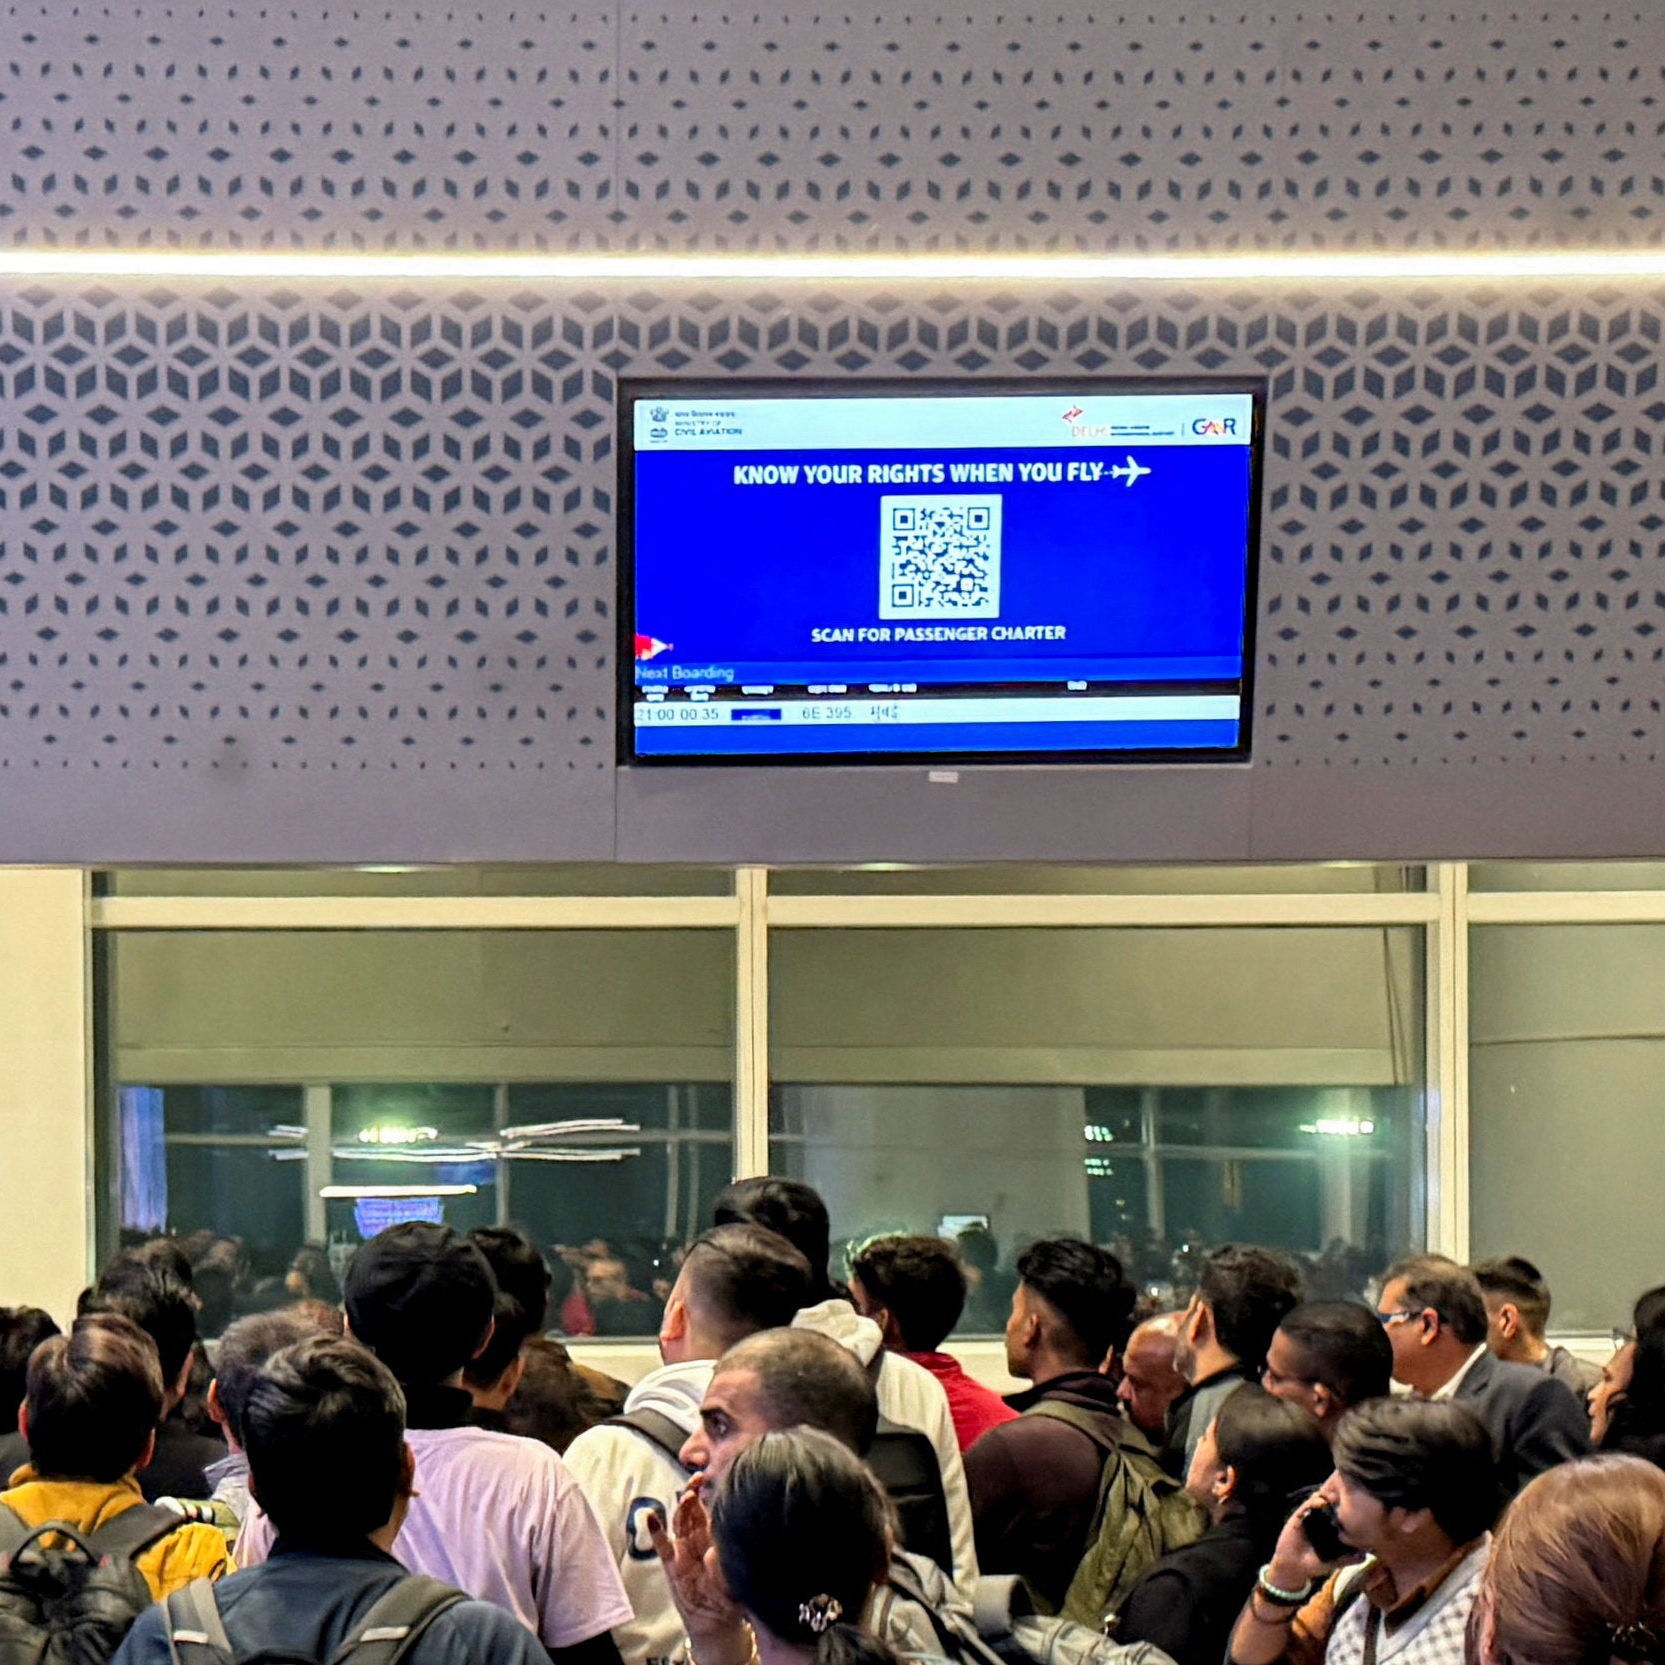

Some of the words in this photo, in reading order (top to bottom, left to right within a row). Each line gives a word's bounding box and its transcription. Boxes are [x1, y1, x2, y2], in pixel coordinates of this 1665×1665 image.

[733, 465, 799, 485] KNOW
[803, 464, 863, 484] YOUR
[867, 463, 945, 484] RIGHTS
[949, 463, 1014, 483] WHEN
[1018, 462, 1063, 483] YOU
[1067, 461, 1104, 482] FLY
[811, 627, 854, 643] SCAN
[858, 627, 891, 642] FOR
[894, 626, 988, 642] PASSENGER
[991, 625, 1067, 641] CHARTER
[672, 663, 734, 683] Boarding
